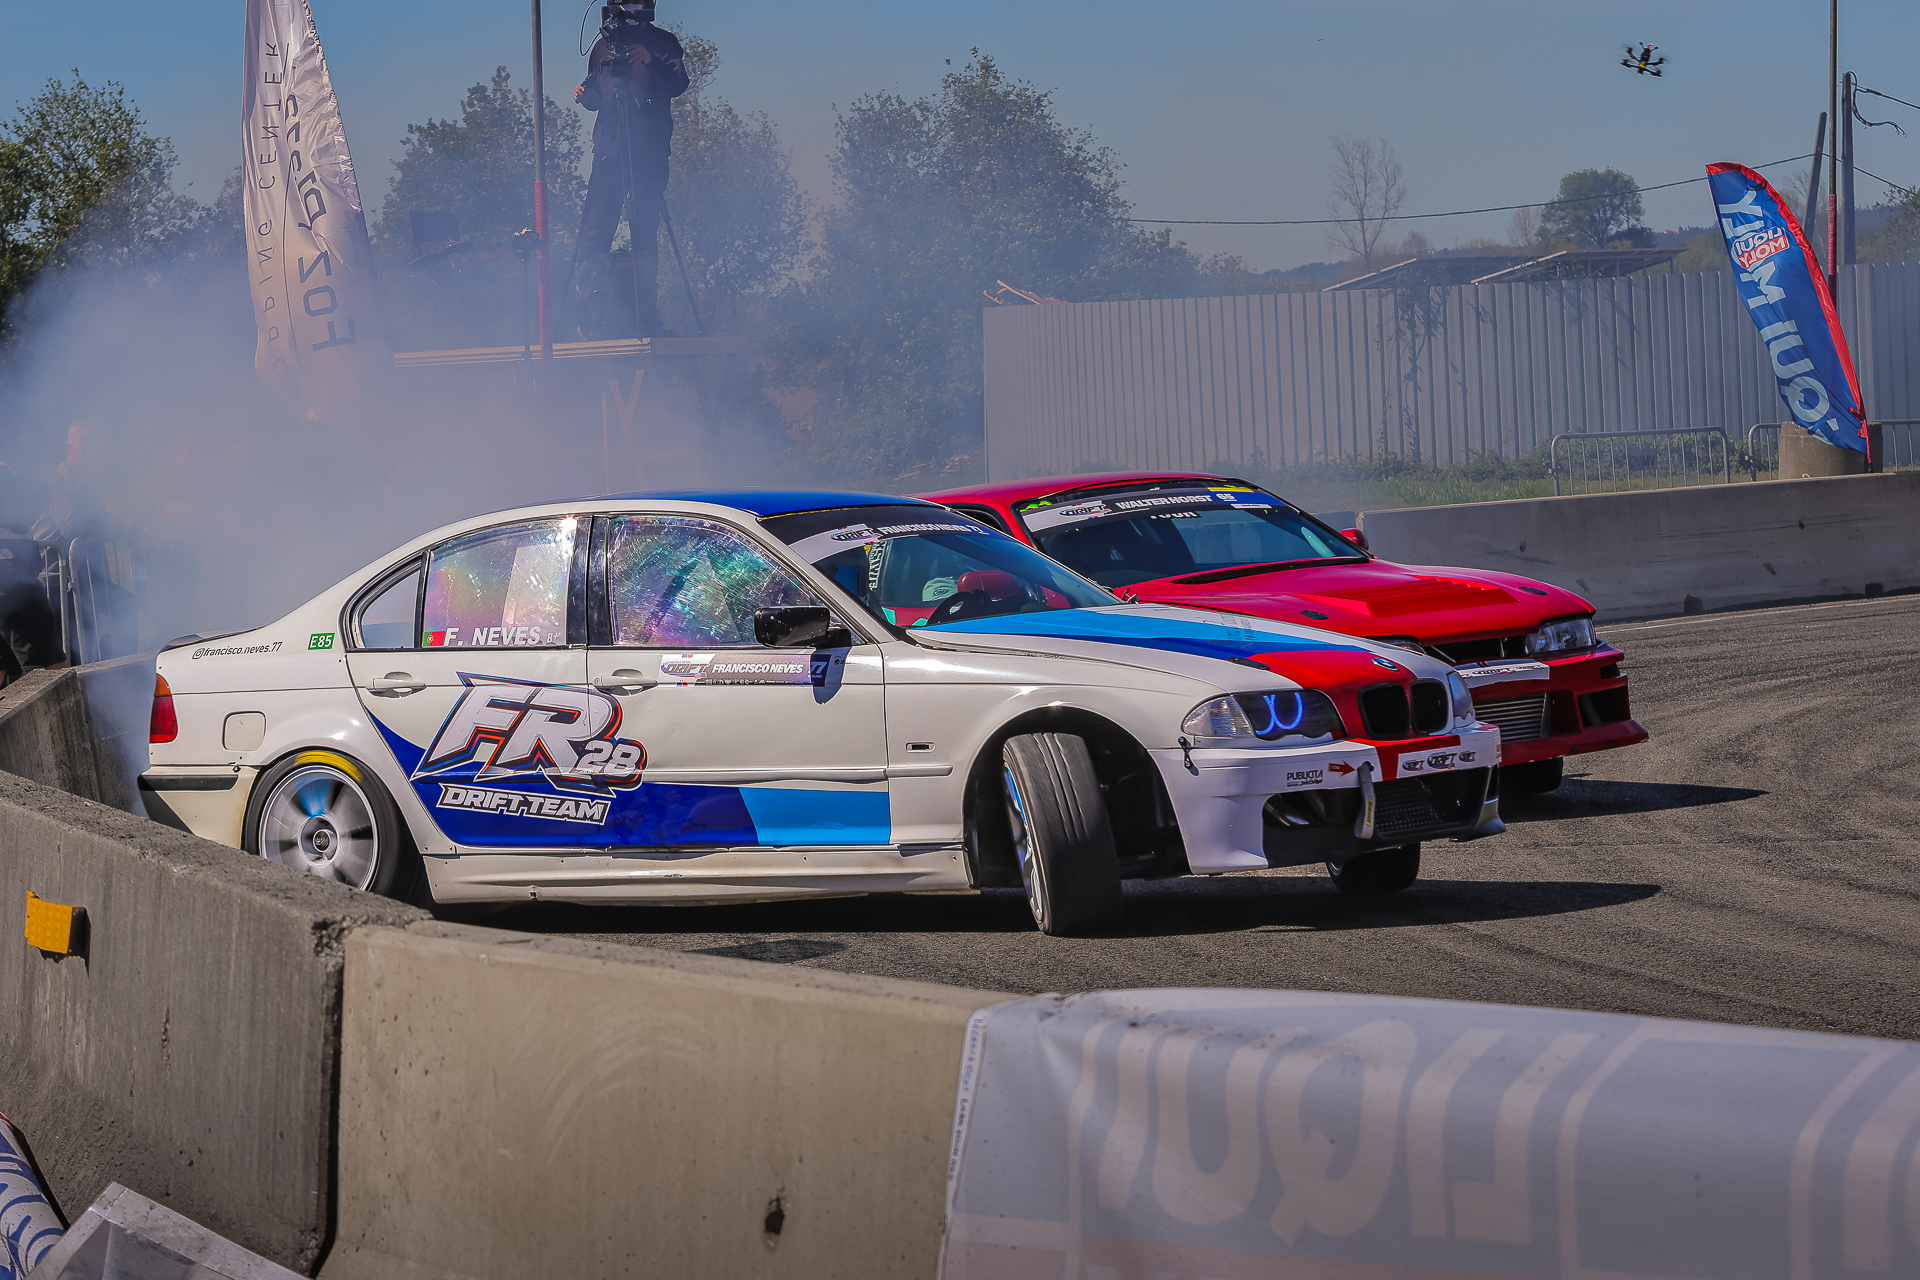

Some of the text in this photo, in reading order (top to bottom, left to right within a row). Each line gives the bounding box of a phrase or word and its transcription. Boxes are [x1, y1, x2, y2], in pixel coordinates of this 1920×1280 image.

[1115, 497, 1170, 510] WALTER
[1168, 494, 1213, 505] HORST
[836, 528, 874, 541] DRIFT
[309, 635, 333, 649] E85
[443, 627, 464, 647] F.
[471, 626, 542, 647] NEVES
[192, 641, 283, 660] @francisco.neves.77
[712, 663, 771, 674] FRANCISCO
[770, 663, 804, 674] NEVES
[422, 680, 643, 779] FR 28
[443, 786, 605, 821] DRIFT TEAM
